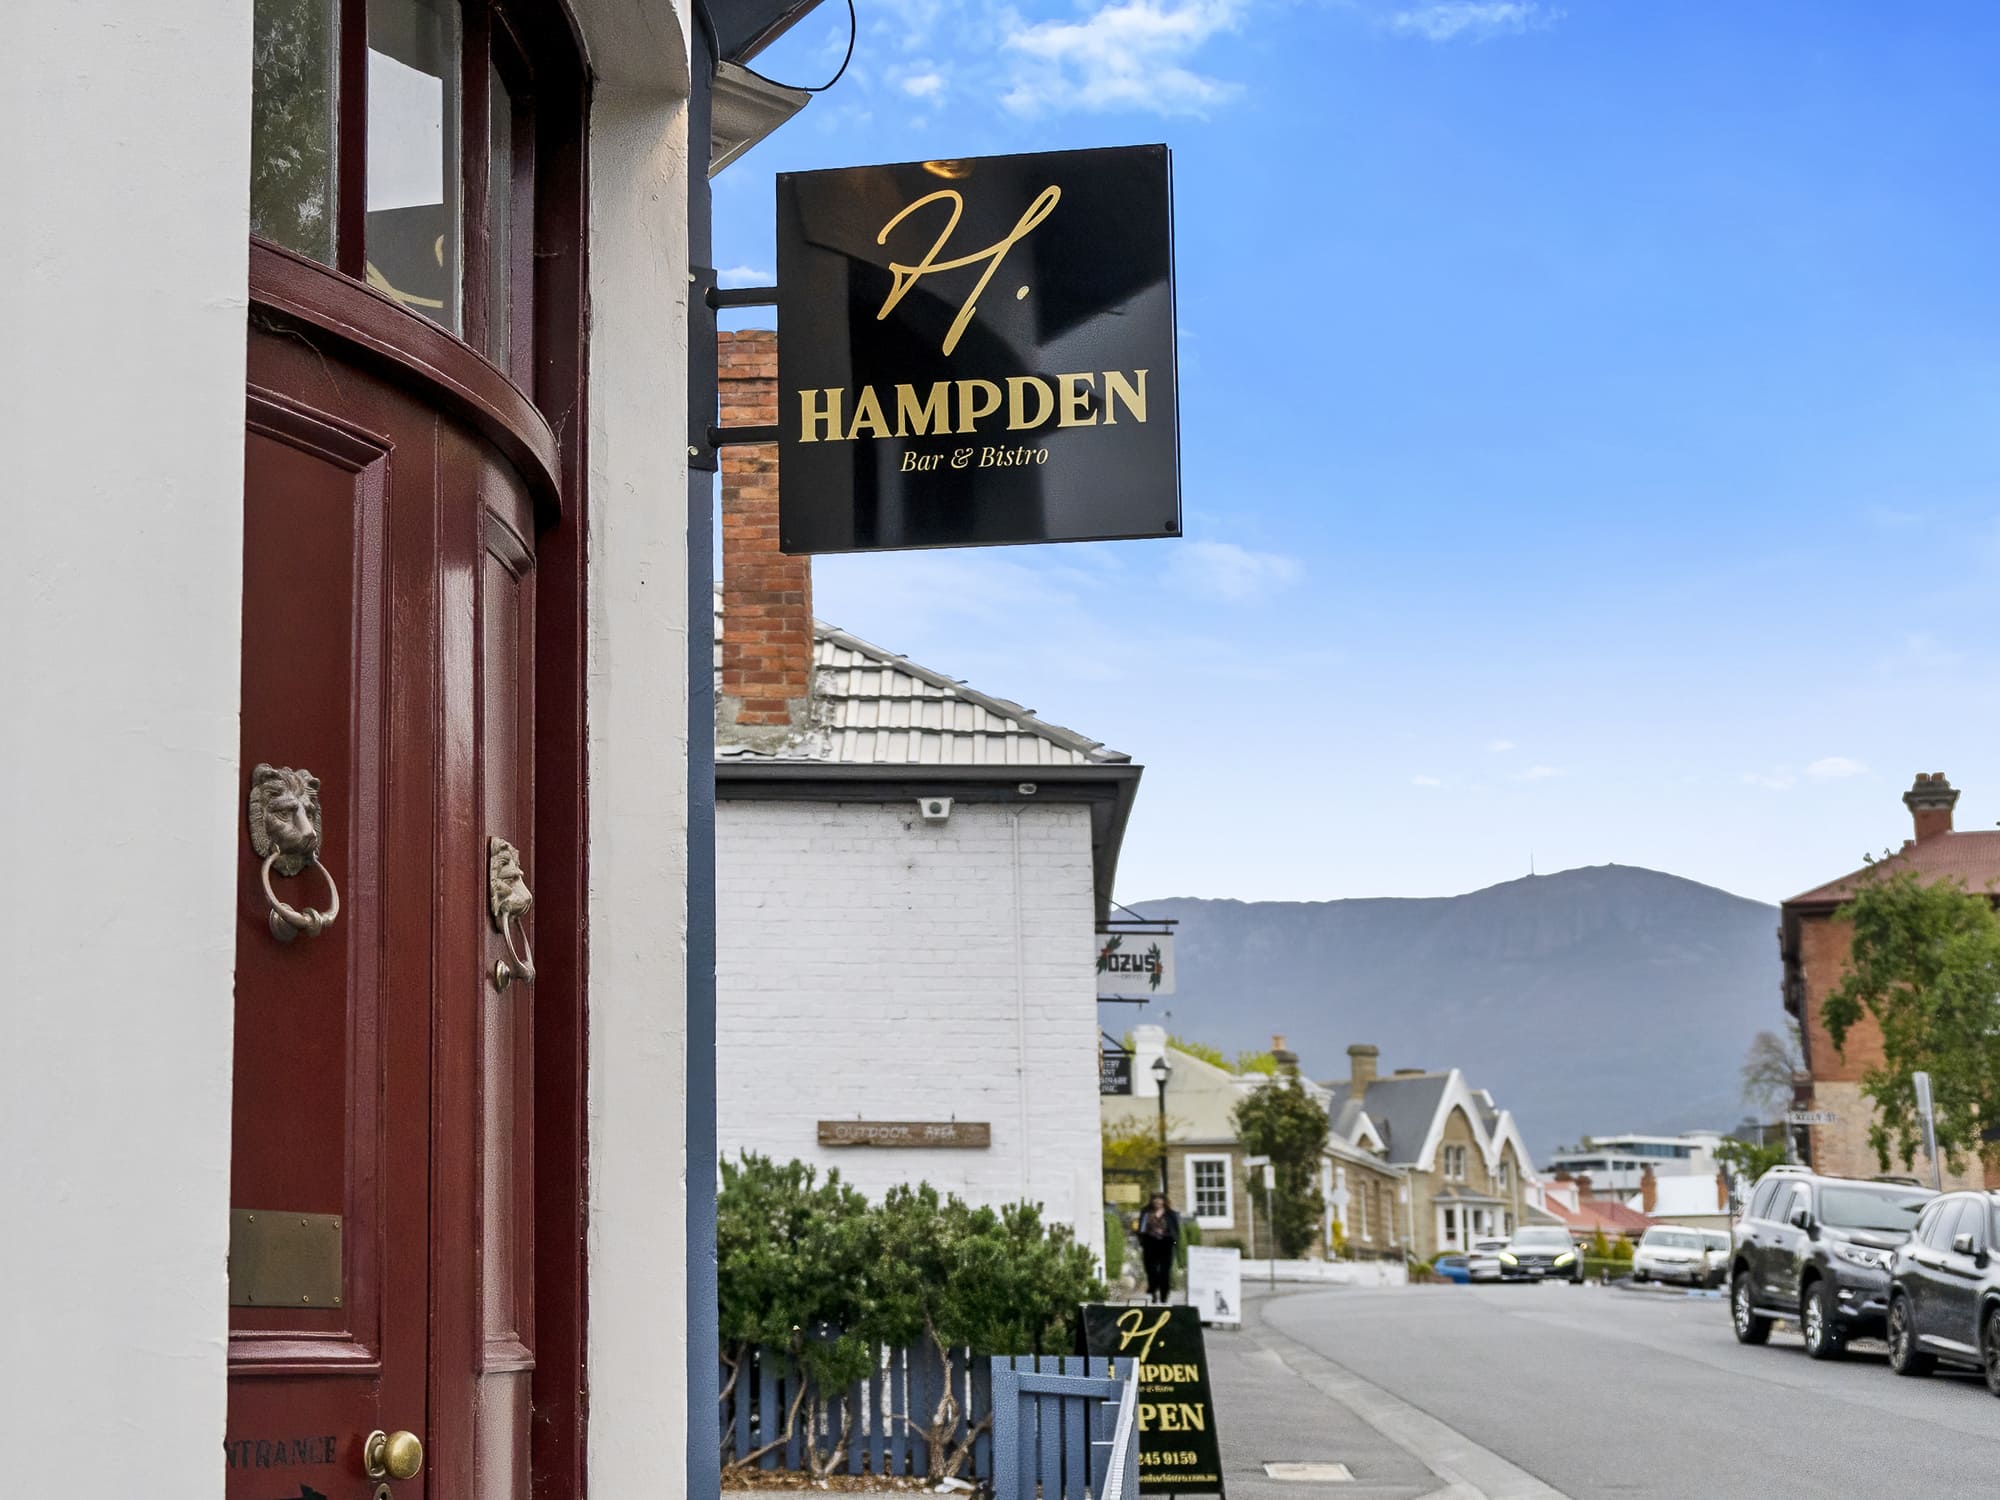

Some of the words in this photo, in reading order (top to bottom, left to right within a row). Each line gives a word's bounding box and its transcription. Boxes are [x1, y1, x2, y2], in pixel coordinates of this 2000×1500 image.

[798, 368, 1150, 444] HAMPDEN
[901, 449, 944, 472] Bar
[950, 447, 974, 469] &
[978, 445, 1049, 469] Bistro
[1138, 1402, 1204, 1432] PEN
[223, 1435, 337, 1469] NTRANCE
[1138, 1451, 1161, 1466] 245
[1163, 1450, 1198, 1465] 9159
